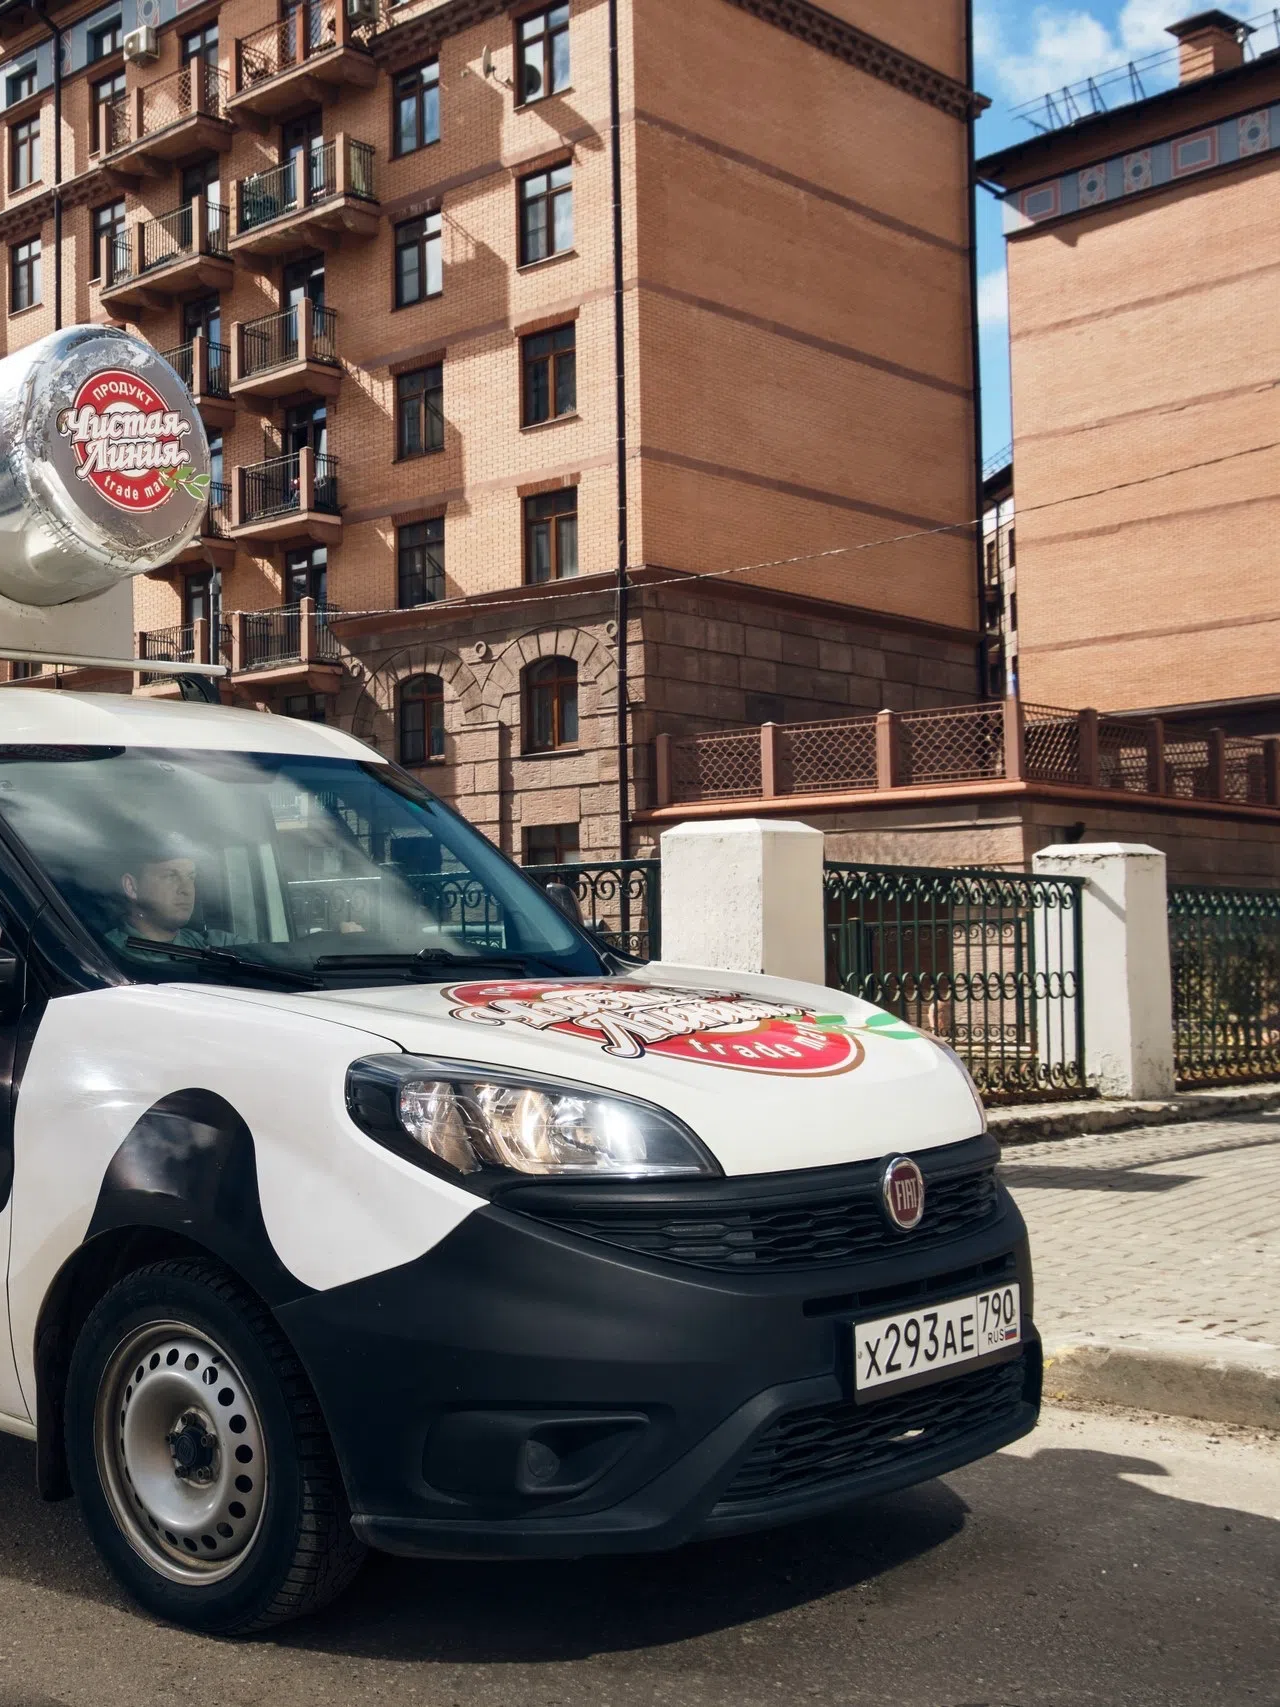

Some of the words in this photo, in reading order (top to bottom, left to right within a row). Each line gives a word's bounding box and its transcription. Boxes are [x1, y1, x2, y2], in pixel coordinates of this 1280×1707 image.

[92, 381, 154, 406] ПРОДУКТ
[56, 403, 192, 446] Чистая
[74, 440, 192, 481] Линия
[104, 475, 139, 500] trade
[144, 470, 170, 498] mark
[688, 1038, 803, 1059] trade
[894, 1178, 918, 1211] FIAT
[979, 1288, 1014, 1333] 790
[987, 1331, 1005, 1345] RUS
